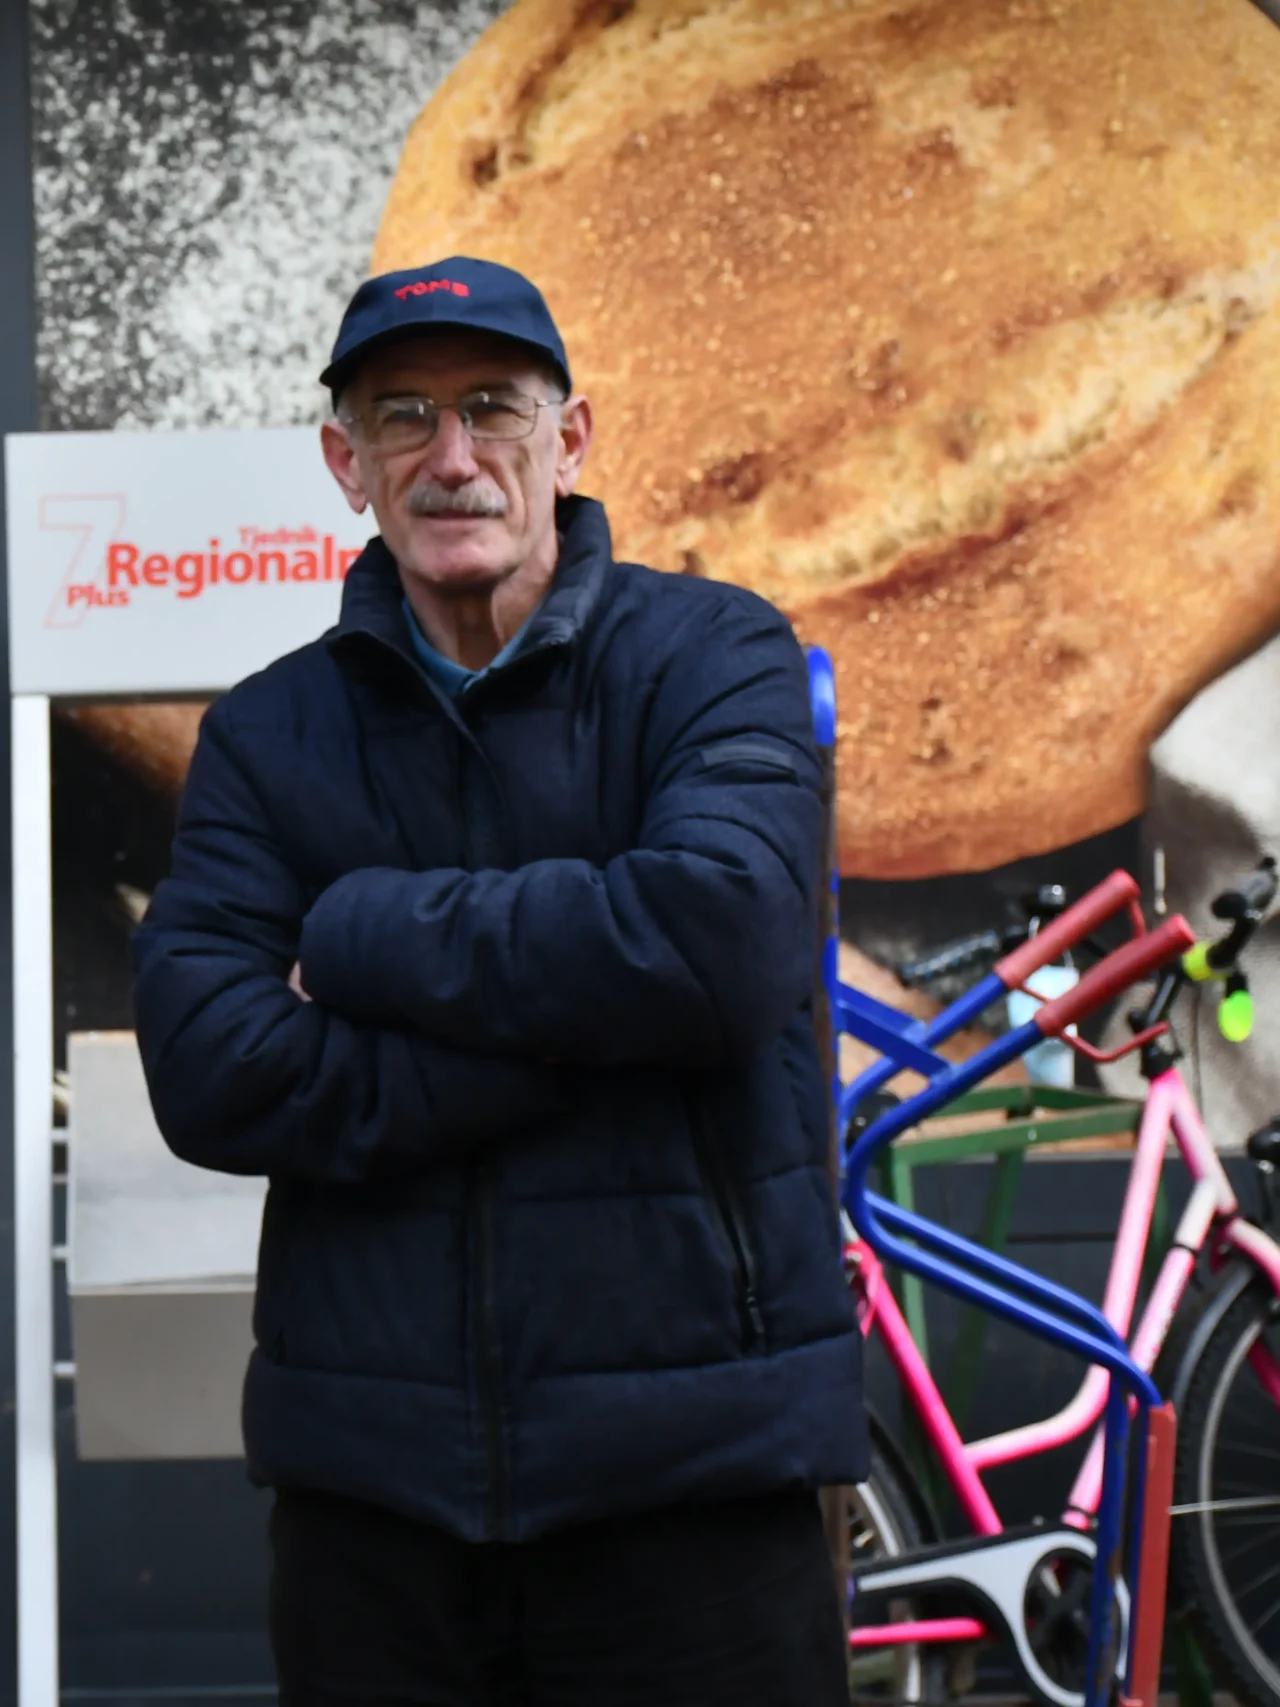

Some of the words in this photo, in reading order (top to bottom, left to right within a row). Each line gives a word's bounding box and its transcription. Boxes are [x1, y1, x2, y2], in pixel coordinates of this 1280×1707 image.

[238, 525, 317, 550] Tjednik
[38, 493, 127, 630] 7
[67, 584, 130, 608] Plus
